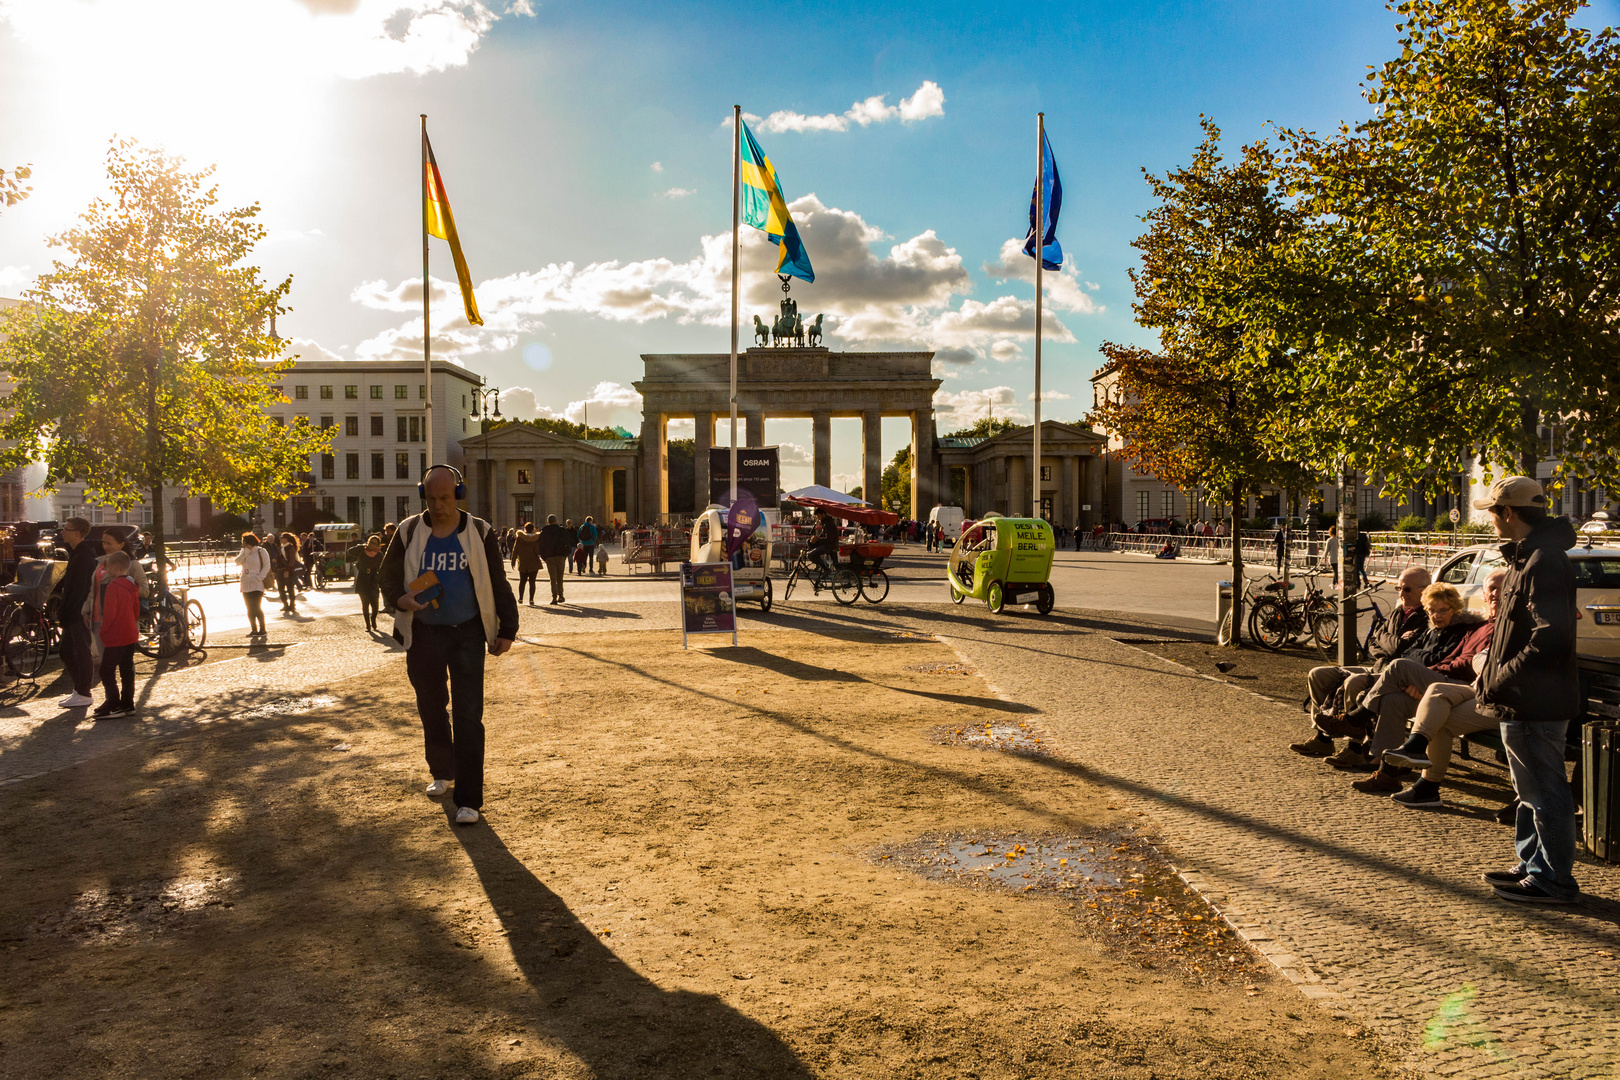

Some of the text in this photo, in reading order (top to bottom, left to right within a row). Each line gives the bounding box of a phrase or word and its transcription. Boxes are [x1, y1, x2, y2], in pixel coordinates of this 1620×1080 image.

[1017, 532, 1046, 540] MEILE.
[1018, 542, 1046, 551] BERLIN
[1604, 614, 1610, 622] B
